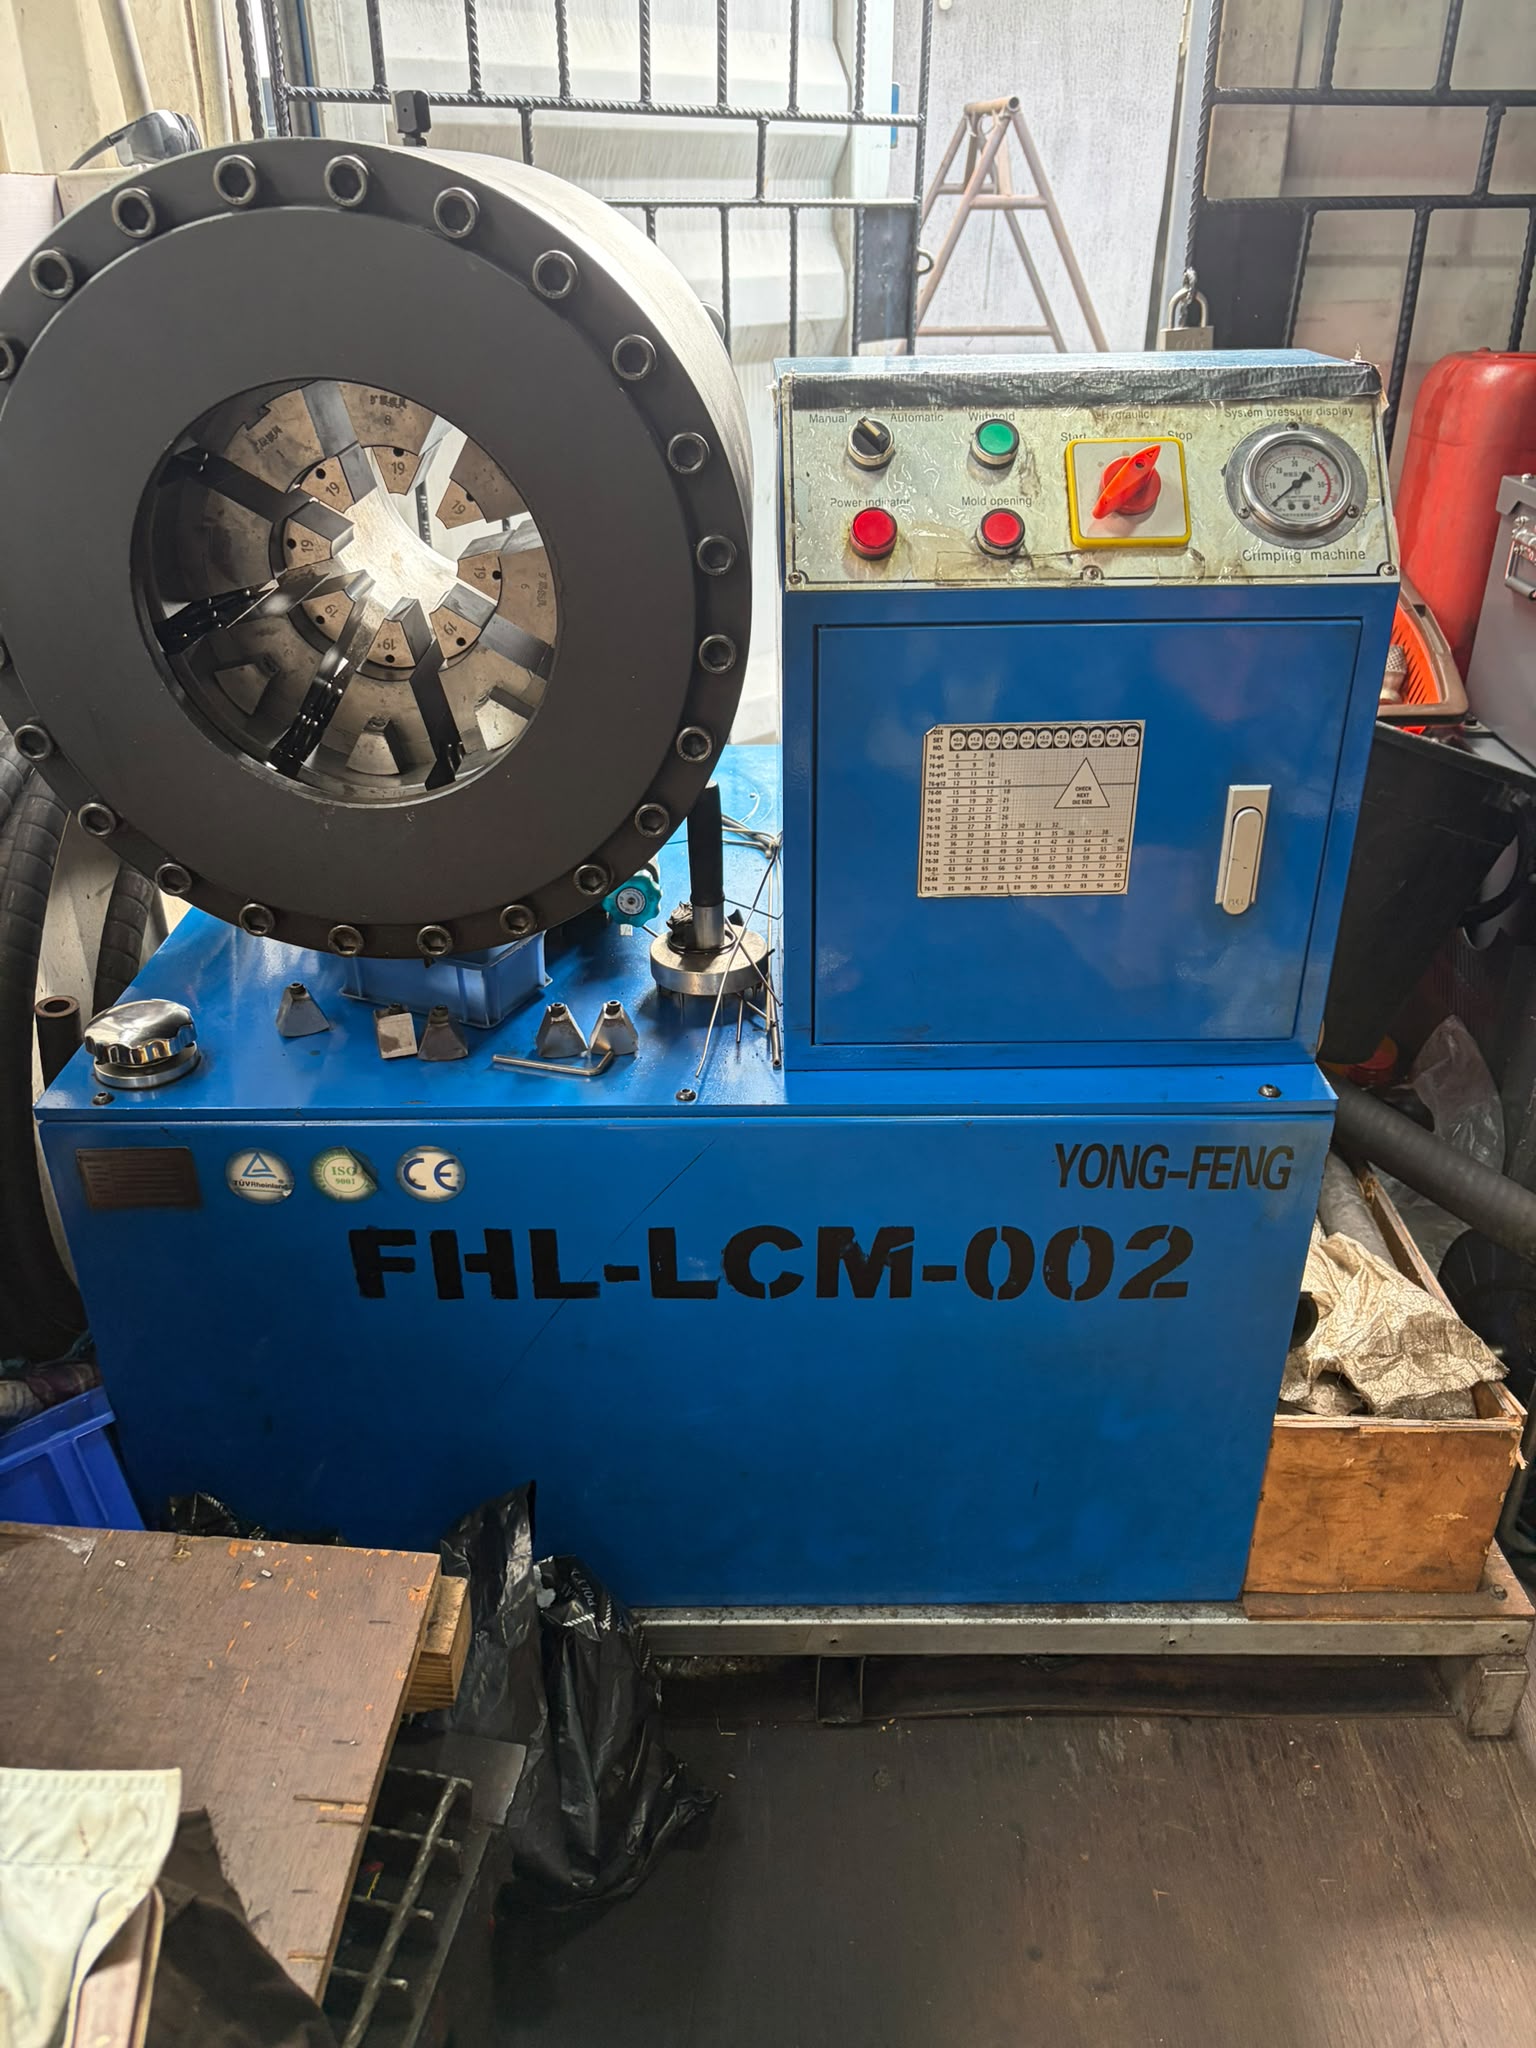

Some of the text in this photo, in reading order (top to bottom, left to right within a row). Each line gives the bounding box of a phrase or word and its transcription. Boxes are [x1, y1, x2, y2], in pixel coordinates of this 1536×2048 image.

[809, 414, 848, 423] Manual
[890, 412, 944, 422] Automatic
[968, 411, 1016, 421] Withhold
[1224, 406, 1354, 419] System pressure display
[384, 415, 392, 425] 8
[1060, 432, 1087, 441] Start
[1167, 430, 1193, 441] Stop
[391, 461, 405, 475] 19
[326, 481, 340, 496] 19
[451, 500, 466, 515] 19
[830, 498, 862, 507] Power
[961, 496, 1033, 508] Mold opening
[301, 539, 314, 553] 19
[1242, 549, 1366, 564] Crimping machine
[474, 566, 485, 580] 19
[324, 603, 339, 618] 19
[443, 621, 457, 636] 19
[382, 638, 397, 651] 19
[331, 1166, 357, 1176] ISO
[1055, 1143, 1294, 1190] YONG-FENG
[403, 1158, 458, 1191] CE
[348, 1224, 1194, 1301] FHL-LCM-002
